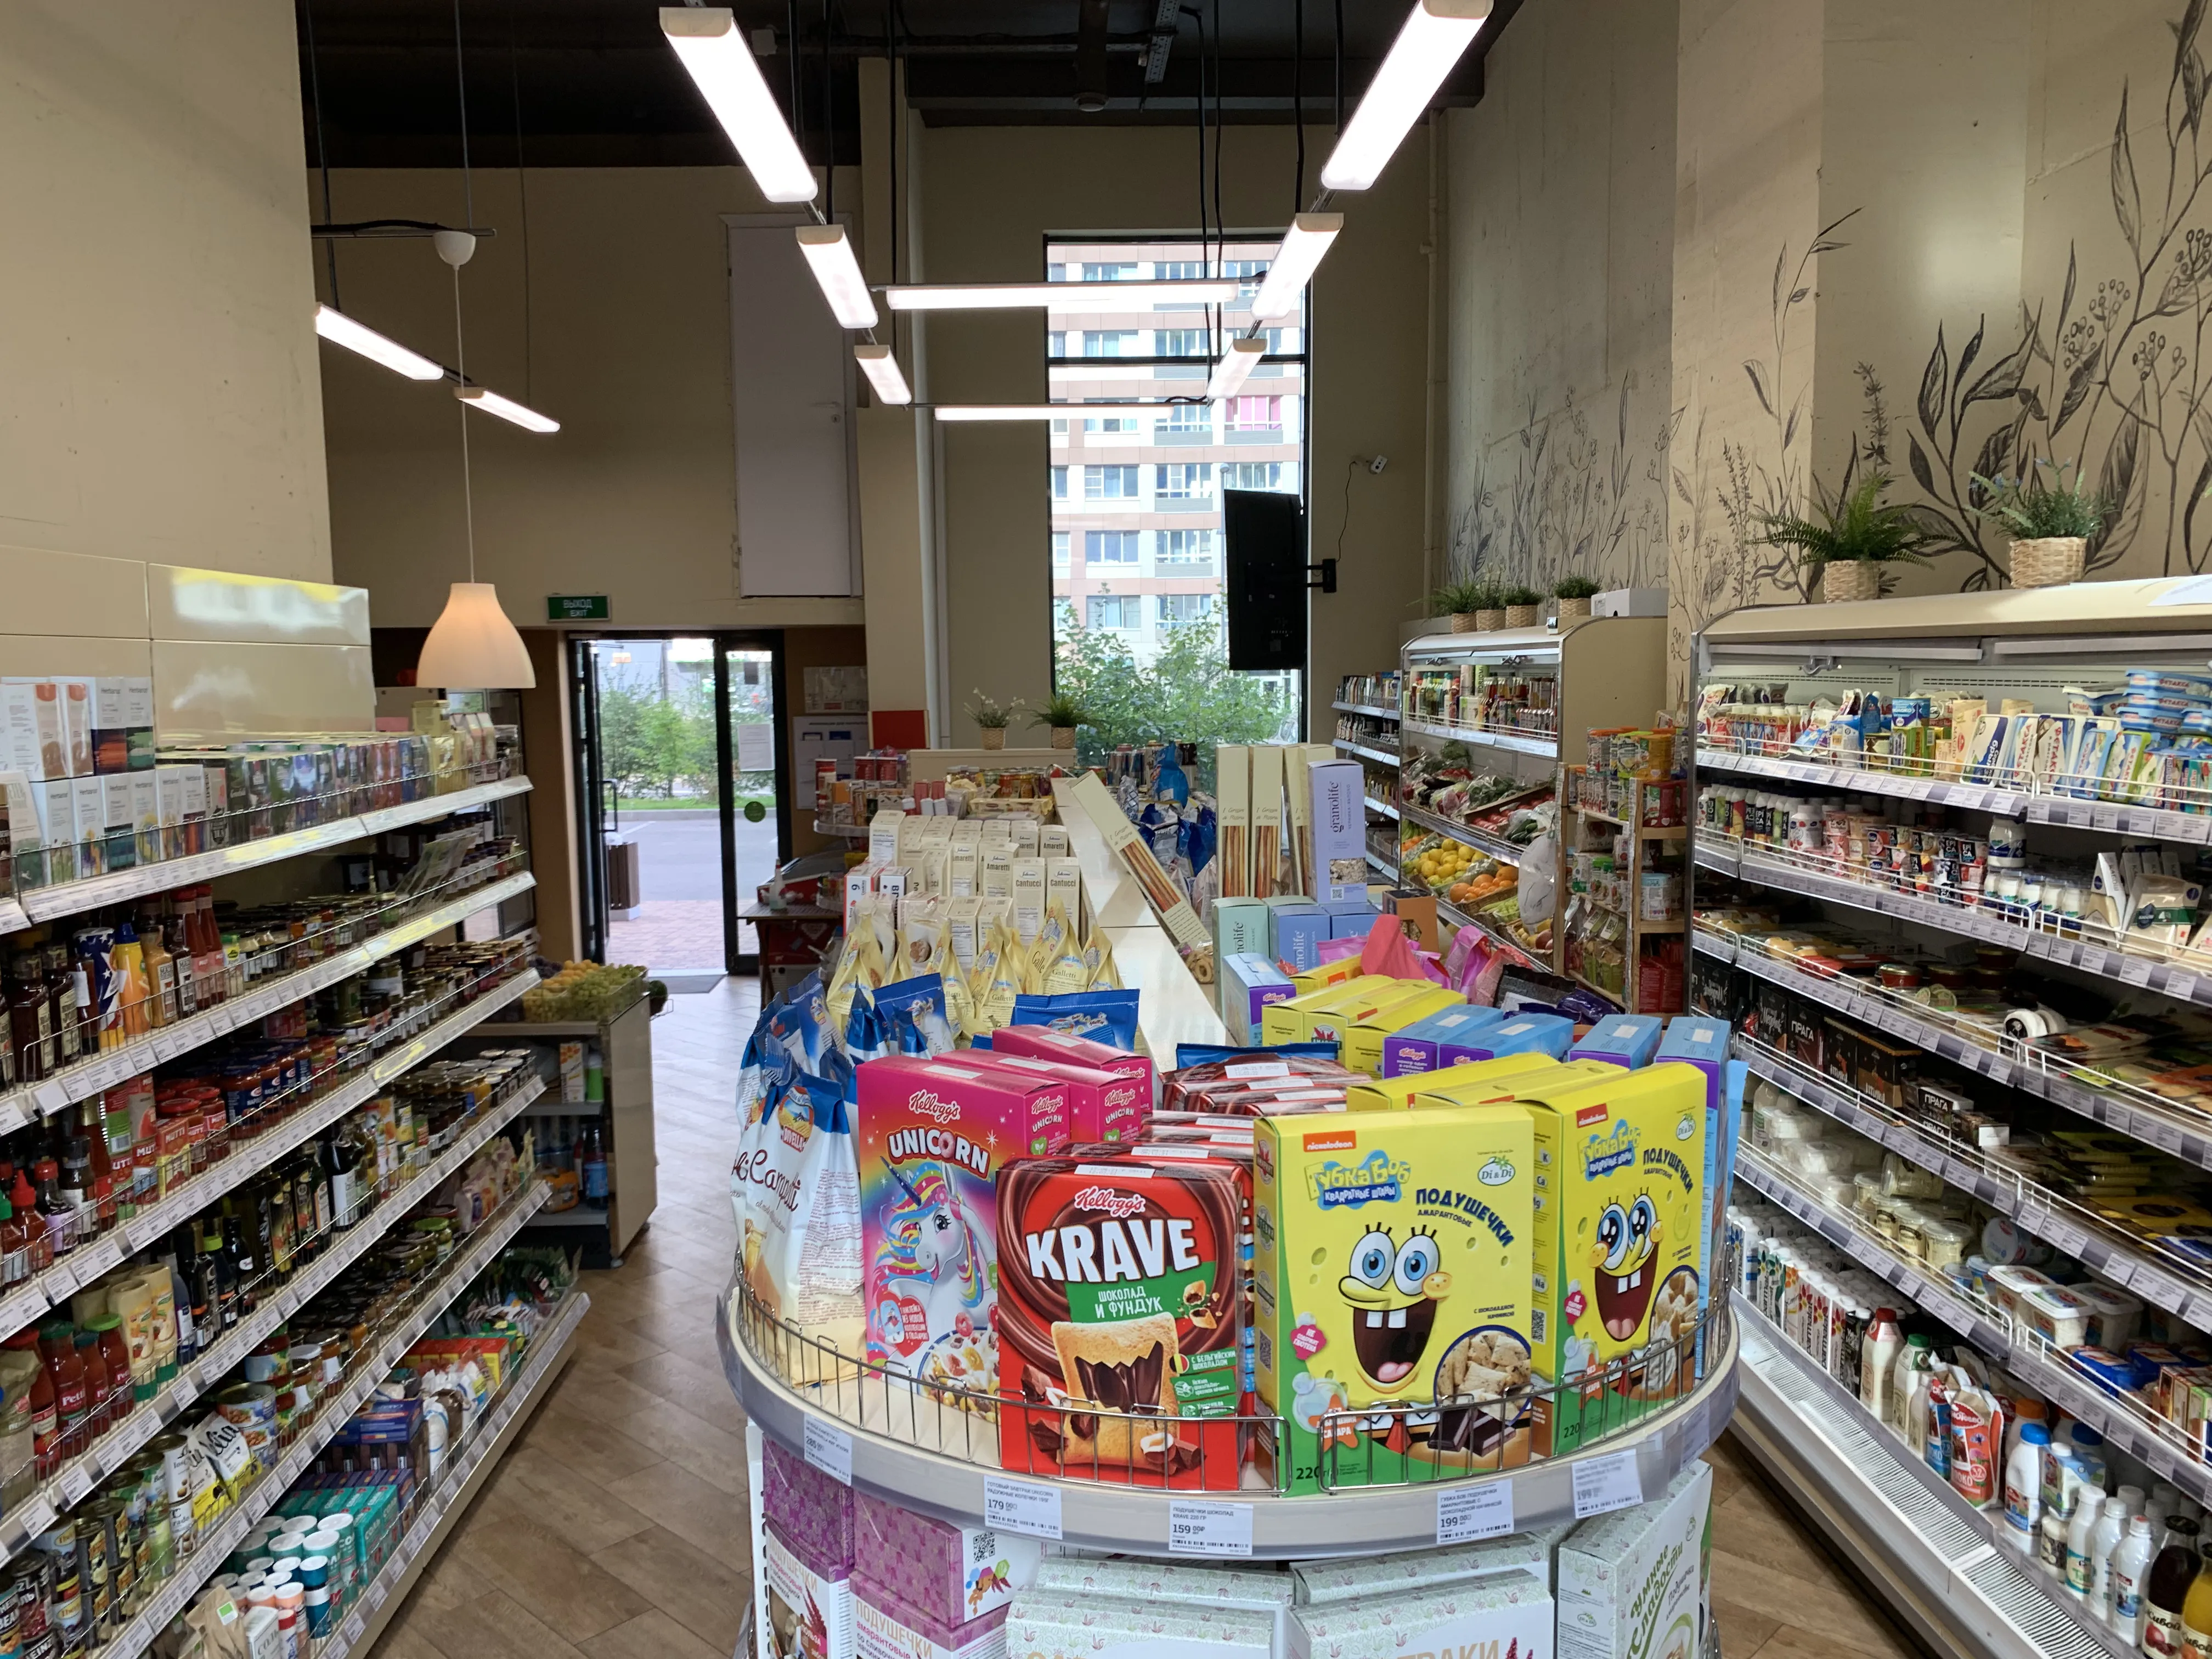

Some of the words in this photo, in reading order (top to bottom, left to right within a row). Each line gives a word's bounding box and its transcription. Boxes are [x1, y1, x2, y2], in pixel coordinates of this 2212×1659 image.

[563, 599, 593, 608] ВЫХОД
[1328, 781, 1344, 833] granolife
[1052, 969, 1076, 978] Galletti
[1263, 993, 1286, 1002] Kellogg's
[1791, 1020, 1814, 1041] ПРАГА
[1399, 1047, 1426, 1060] Kellogg's
[1105, 1089, 1135, 1106] Kellogg's
[1925, 1094, 1948, 1111] ПРАГА
[909, 1089, 961, 1124] Kellogg's
[1031, 1096, 1063, 1114] Kellogg's
[1105, 1108, 1135, 1124] UNICORN
[1032, 1115, 1062, 1133] UNICORN
[166, 1127, 185, 1143] MUTTI
[889, 1128, 988, 1173] UNICORN
[1307, 1141, 1353, 1150] nickelodeon
[1543, 1153, 1548, 1163] K
[1482, 1170, 1493, 1180] Di
[1501, 1167, 1513, 1177] Di
[1644, 1148, 1694, 1195] ПОДУШЕЧКИ
[1644, 1168, 1673, 1180] АМАРАНТОВЫЕ
[1537, 1176, 1545, 1186] Ca
[1324, 1188, 1370, 1203] КВАДРАТНЫЕ
[1372, 1186, 1396, 1199] ШТАНЫ
[1074, 1186, 1146, 1217] Kellogg's
[1416, 1188, 1514, 1248] ПОДУШЕЧКИ
[1417, 1209, 1472, 1228] АМАРАНТОВЫЕ
[1026, 1219, 1200, 1283] KRAVE
[1535, 1278, 1545, 1289] Na
[1098, 1286, 1146, 1302] ШОКОЛАД
[1095, 1304, 1105, 1318] И
[1108, 1297, 1163, 1316] ФУНДУК
[1479, 1304, 1515, 1313] ШОКОЛАДНОЙ
[1487, 1311, 1515, 1319] НАЧИНКОЙ
[1297, 1333, 1319, 1345] СОДЕРЖИТ
[1306, 1328, 1316, 1338] НЕ
[1293, 1339, 1317, 1352] ГЛЮТЕНА
[1197, 1351, 1235, 1362] БЕЛЬГИЙСКИМ
[1192, 1359, 1228, 1370] ШОКОЛАДОМ
[988, 1481, 1009, 1489] ГОТОВЫЙ
[988, 1488, 1013, 1497] РАДУЖНЫЕ
[1467, 1488, 1497, 1498] ПОДУШЕЧКИ
[988, 1499, 1004, 1510] 179
[1440, 1505, 1475, 1515] ШОКОЛАДНОЙ
[1476, 1500, 1502, 1509] НАЧИНКОЙ
[1441, 1499, 1476, 1508] АМАРАНТОВЫЕ
[1441, 1517, 1458, 1527] 199
[1173, 1524, 1190, 1534] 159
[769, 1534, 817, 1593] ПОДУШЕЧКИ
[856, 1599, 932, 1659] ПОДУШЕЧКИ
[857, 1633, 865, 1643] со
